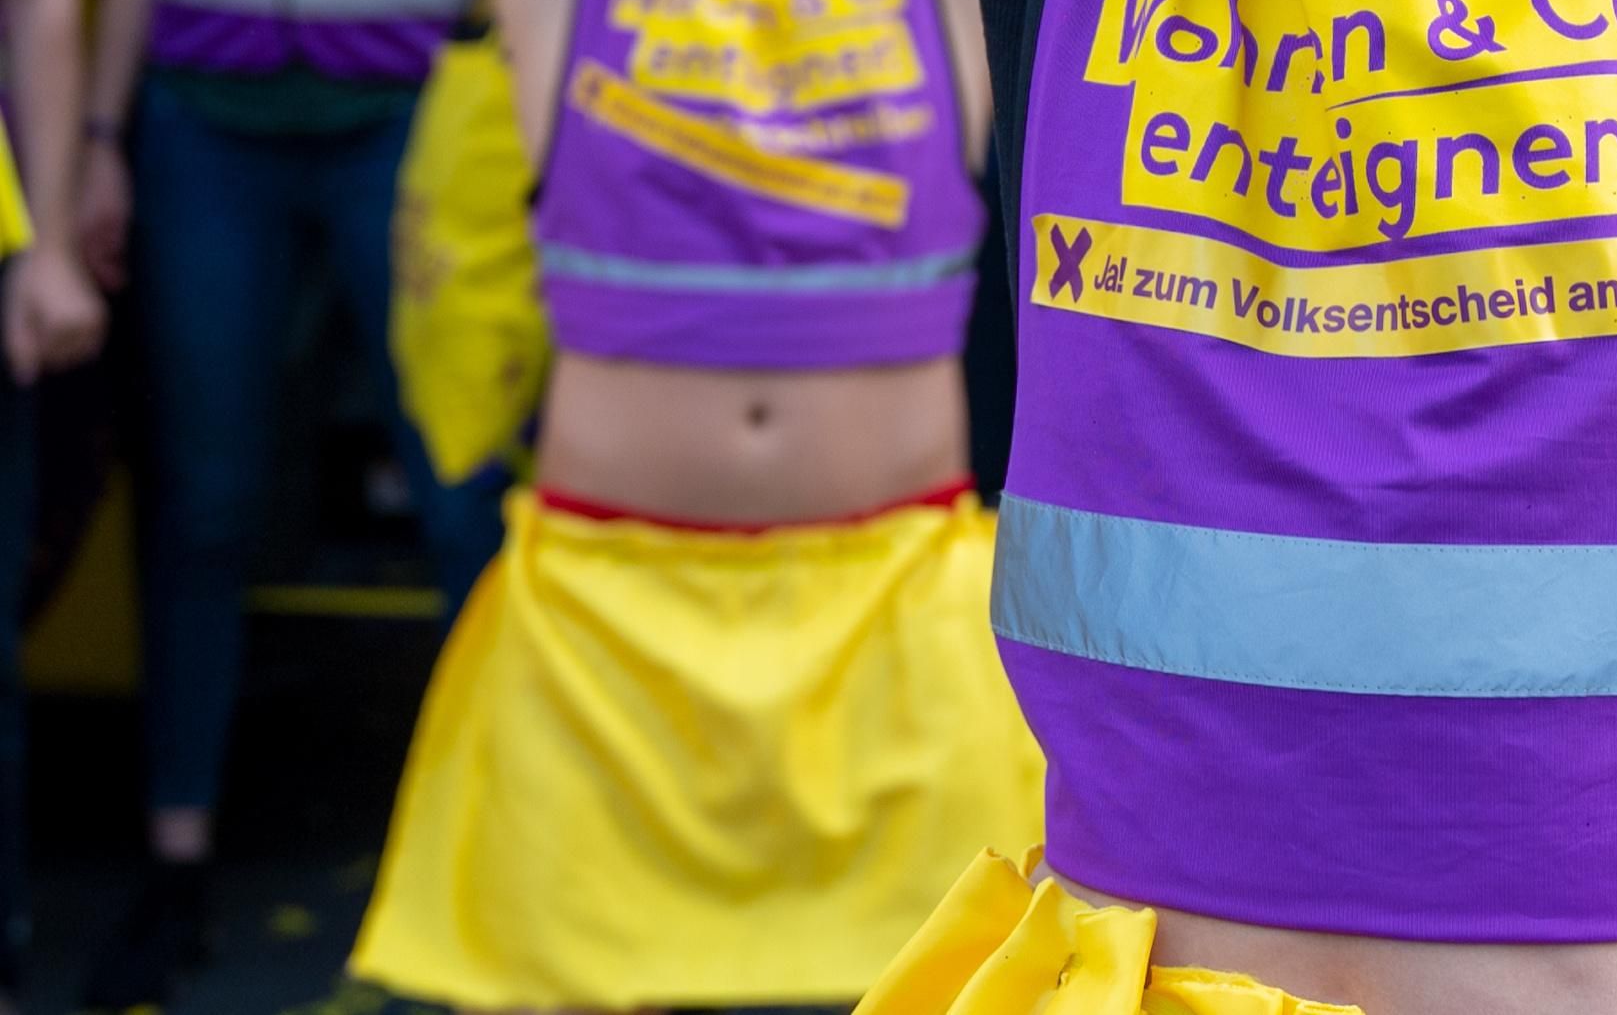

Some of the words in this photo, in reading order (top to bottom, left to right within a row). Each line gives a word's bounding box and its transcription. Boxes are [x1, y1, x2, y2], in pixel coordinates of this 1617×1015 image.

[1094, 255, 1127, 293] Ja!
[1133, 268, 1217, 309] zum
[1231, 276, 1555, 332] Volksentscheid
